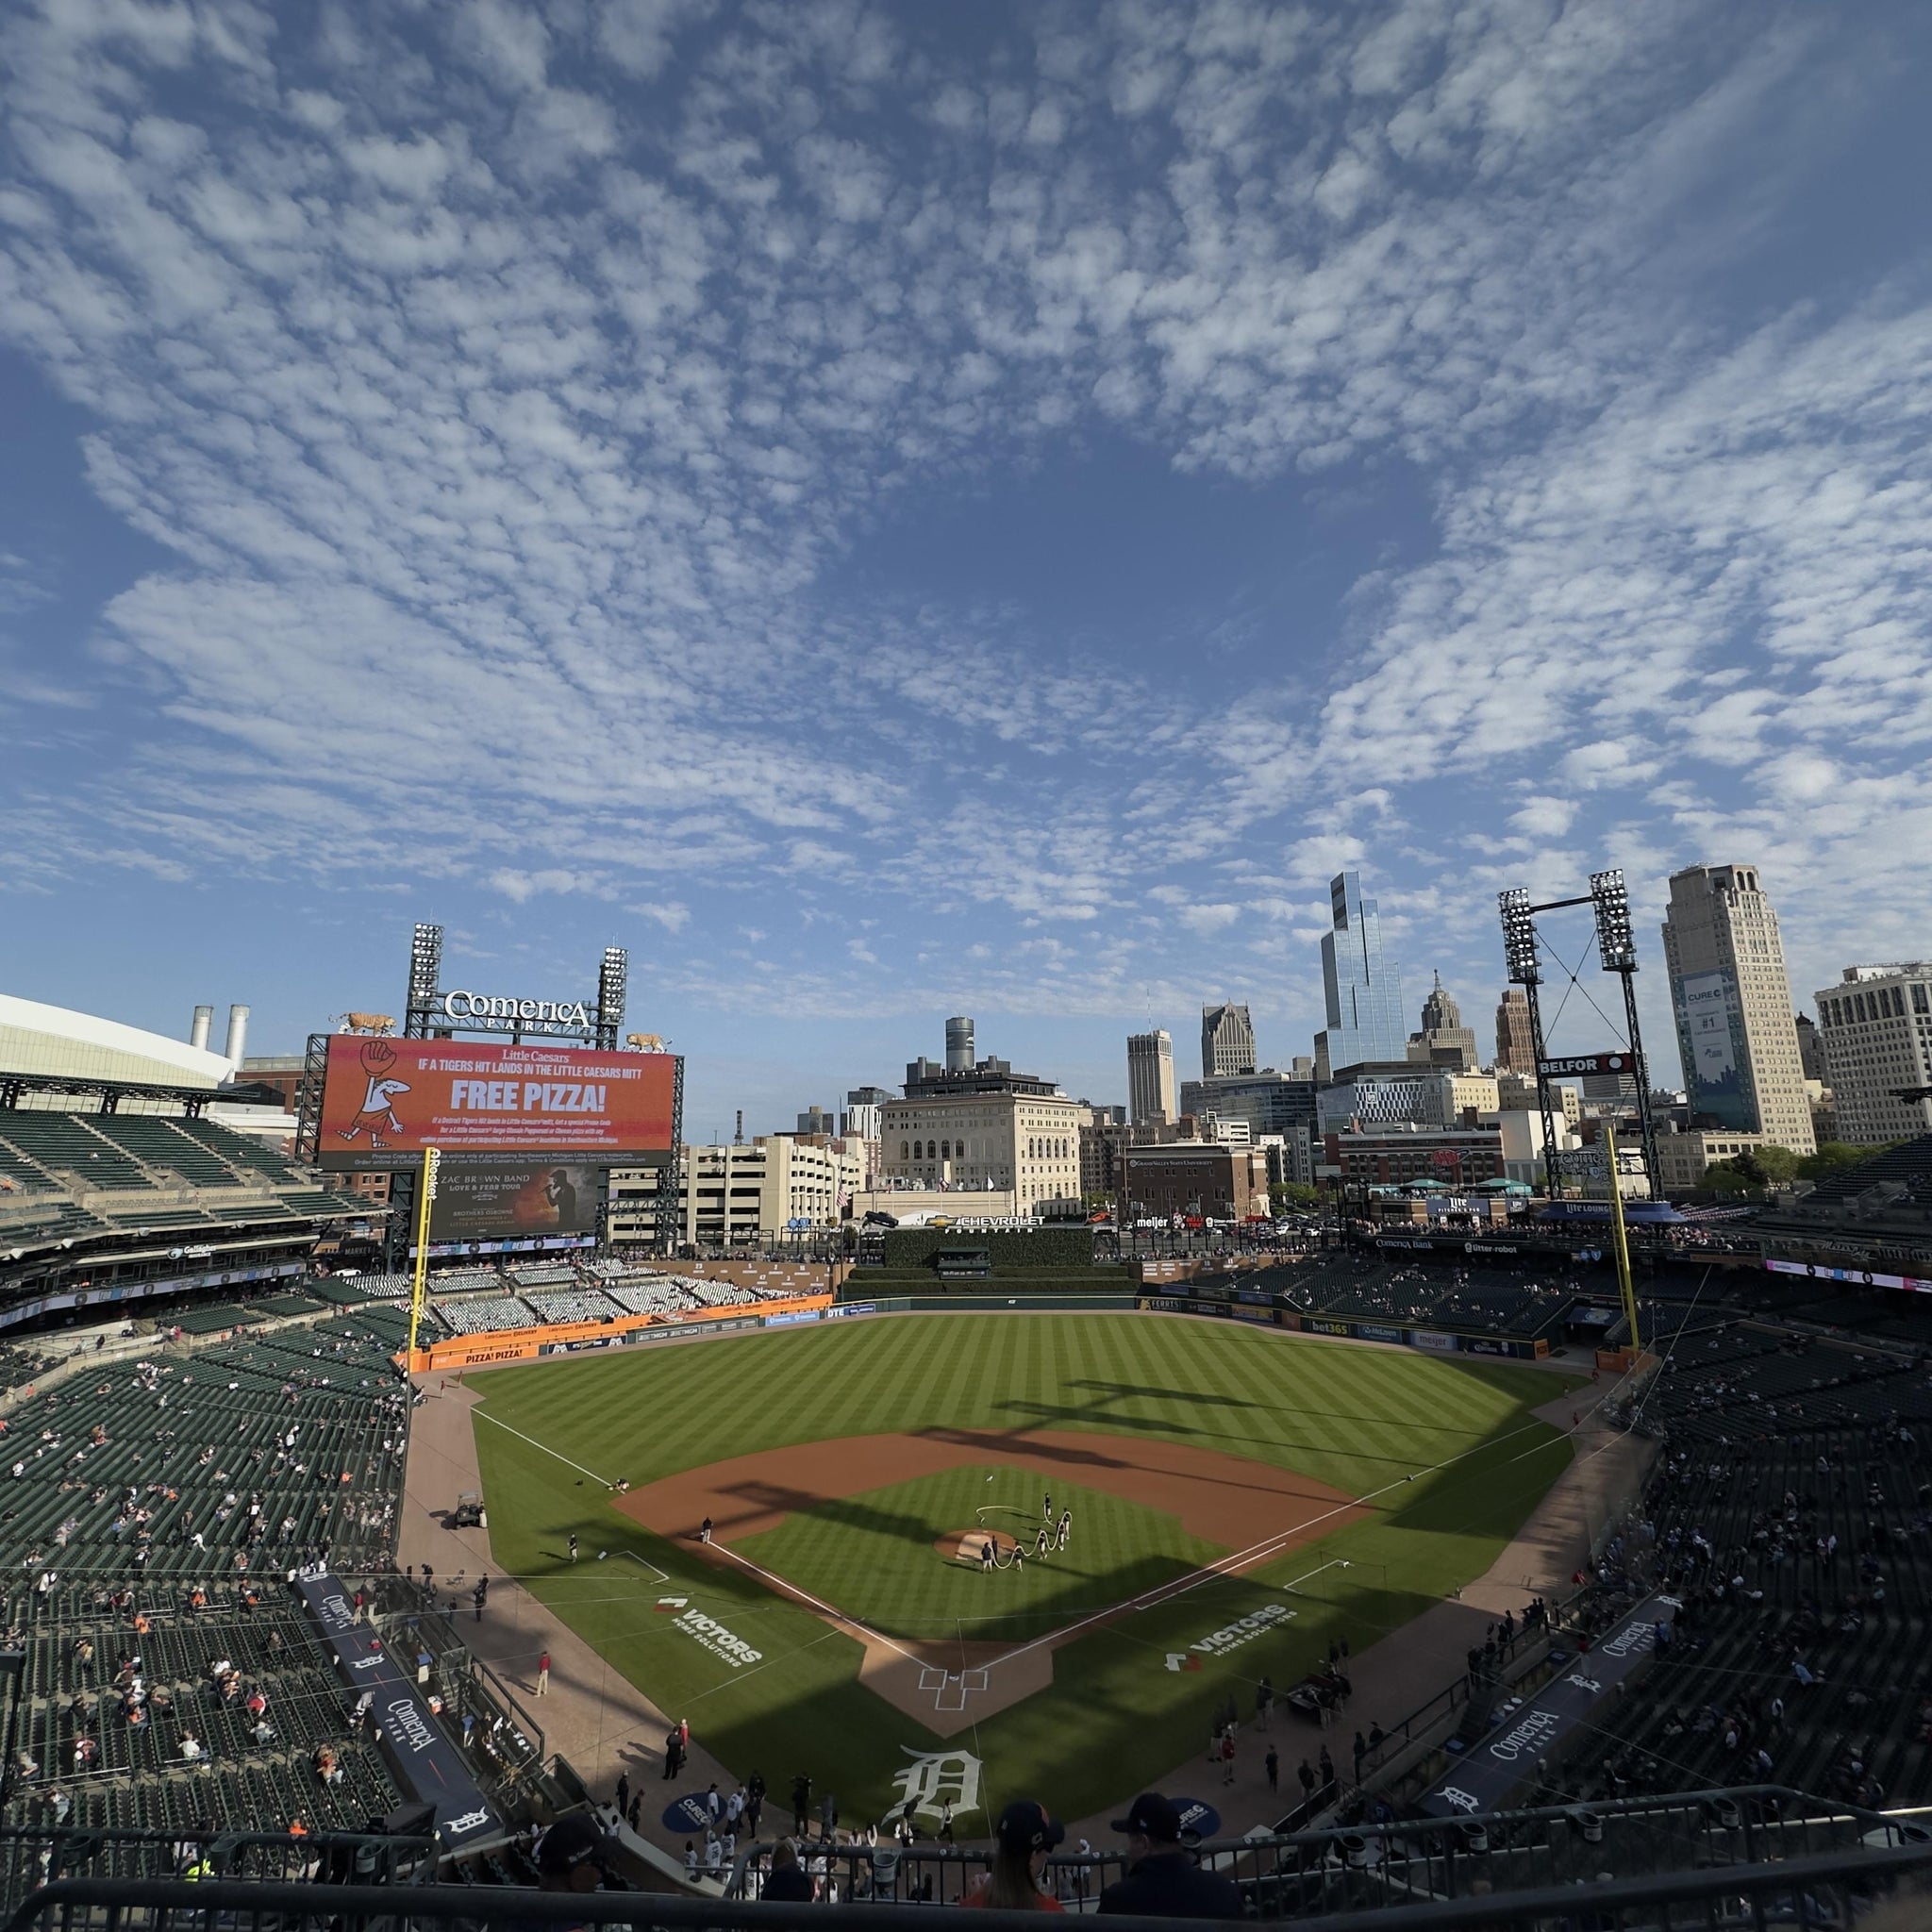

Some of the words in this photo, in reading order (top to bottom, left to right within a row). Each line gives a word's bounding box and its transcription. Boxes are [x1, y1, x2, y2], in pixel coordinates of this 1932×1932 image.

[486, 1018, 554, 1032] PARK
[1702, 1017, 1714, 1028] #1
[502, 1049, 529, 1061] Little
[530, 1050, 570, 1063] Caesars
[418, 1058, 429, 1070] IF
[429, 1058, 437, 1071] A
[439, 1058, 474, 1072] TIGERS
[475, 1060, 491, 1073] HIT
[492, 1061, 523, 1074] LANDS
[524, 1063, 534, 1074] IN
[535, 1063, 552, 1075] THE
[553, 1065, 582, 1076] LITTLE
[584, 1066, 621, 1078] CAESARS
[622, 1068, 642, 1079] MITT
[1540, 1058, 1597, 1074] BELFOR
[450, 1079, 520, 1110] FREE
[523, 1082, 607, 1112] PIZZA!
[427, 1159, 441, 1200] Rocket
[441, 1175, 461, 1184] ZAC
[1449, 1197, 1467, 1208] Lite
[1566, 1204, 1583, 1214] Lite
[1583, 1204, 1609, 1212] LOUNG
[961, 1216, 1045, 1225] CHEVROLET
[1137, 1217, 1168, 1229] meijer
[184, 1243, 217, 1254] Gallagher
[344, 1246, 372, 1256] MARKET
[1412, 1240, 1434, 1249] Bank
[1151, 1300, 1179, 1308] FERRIS
[827, 1308, 844, 1318] DTE
[1312, 1321, 1348, 1335] bet365
[1419, 1334, 1447, 1347] meijer
[466, 1352, 493, 1363] PIZZA!
[495, 1349, 523, 1360] PIZZA!
[1189, 1604, 1287, 1652] VICTORS
[1213, 1639, 1245, 1657] HOME
[1243, 1610, 1298, 1640] SOLUTIONS
[672, 1617, 696, 1635] HOME
[693, 1633, 742, 1668] SOLUTIONS
[682, 1608, 762, 1663] VICTORS
[384, 1717, 407, 1743] PARK
[1525, 1727, 1557, 1754] PARK
